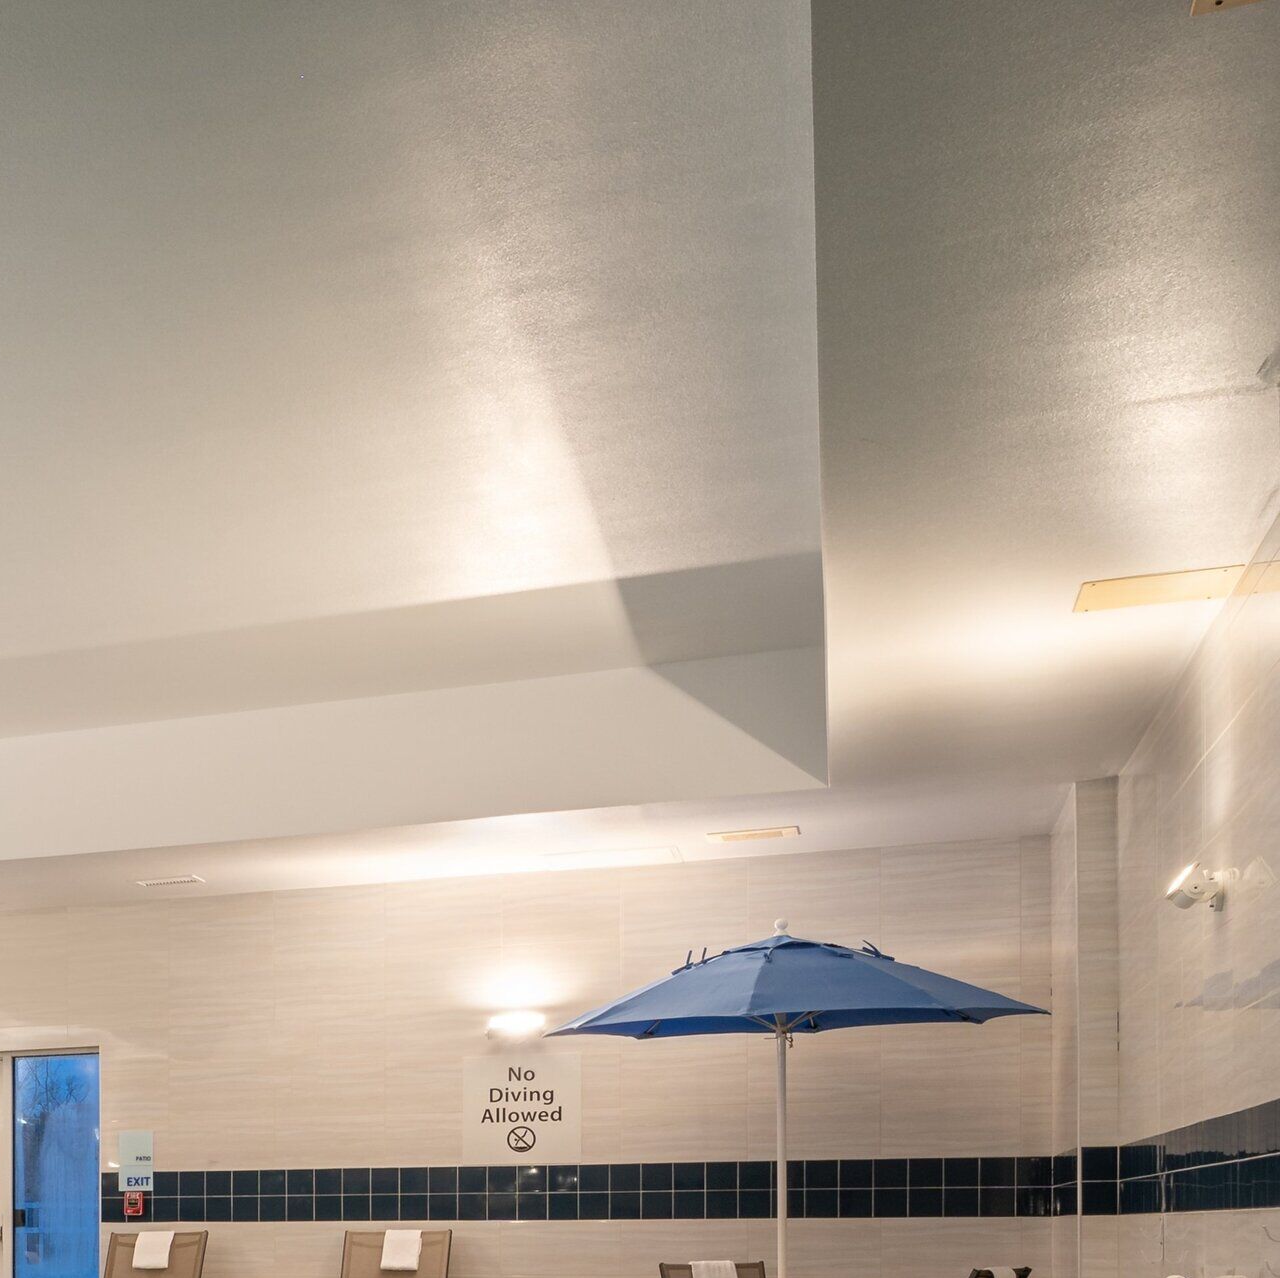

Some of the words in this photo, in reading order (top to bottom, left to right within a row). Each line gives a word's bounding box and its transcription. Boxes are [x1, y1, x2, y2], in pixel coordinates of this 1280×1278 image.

[508, 1067, 535, 1082] No
[489, 1087, 554, 1105] Diving
[481, 1106, 563, 1123] Allowed
[127, 1177, 151, 1186] EXIT
